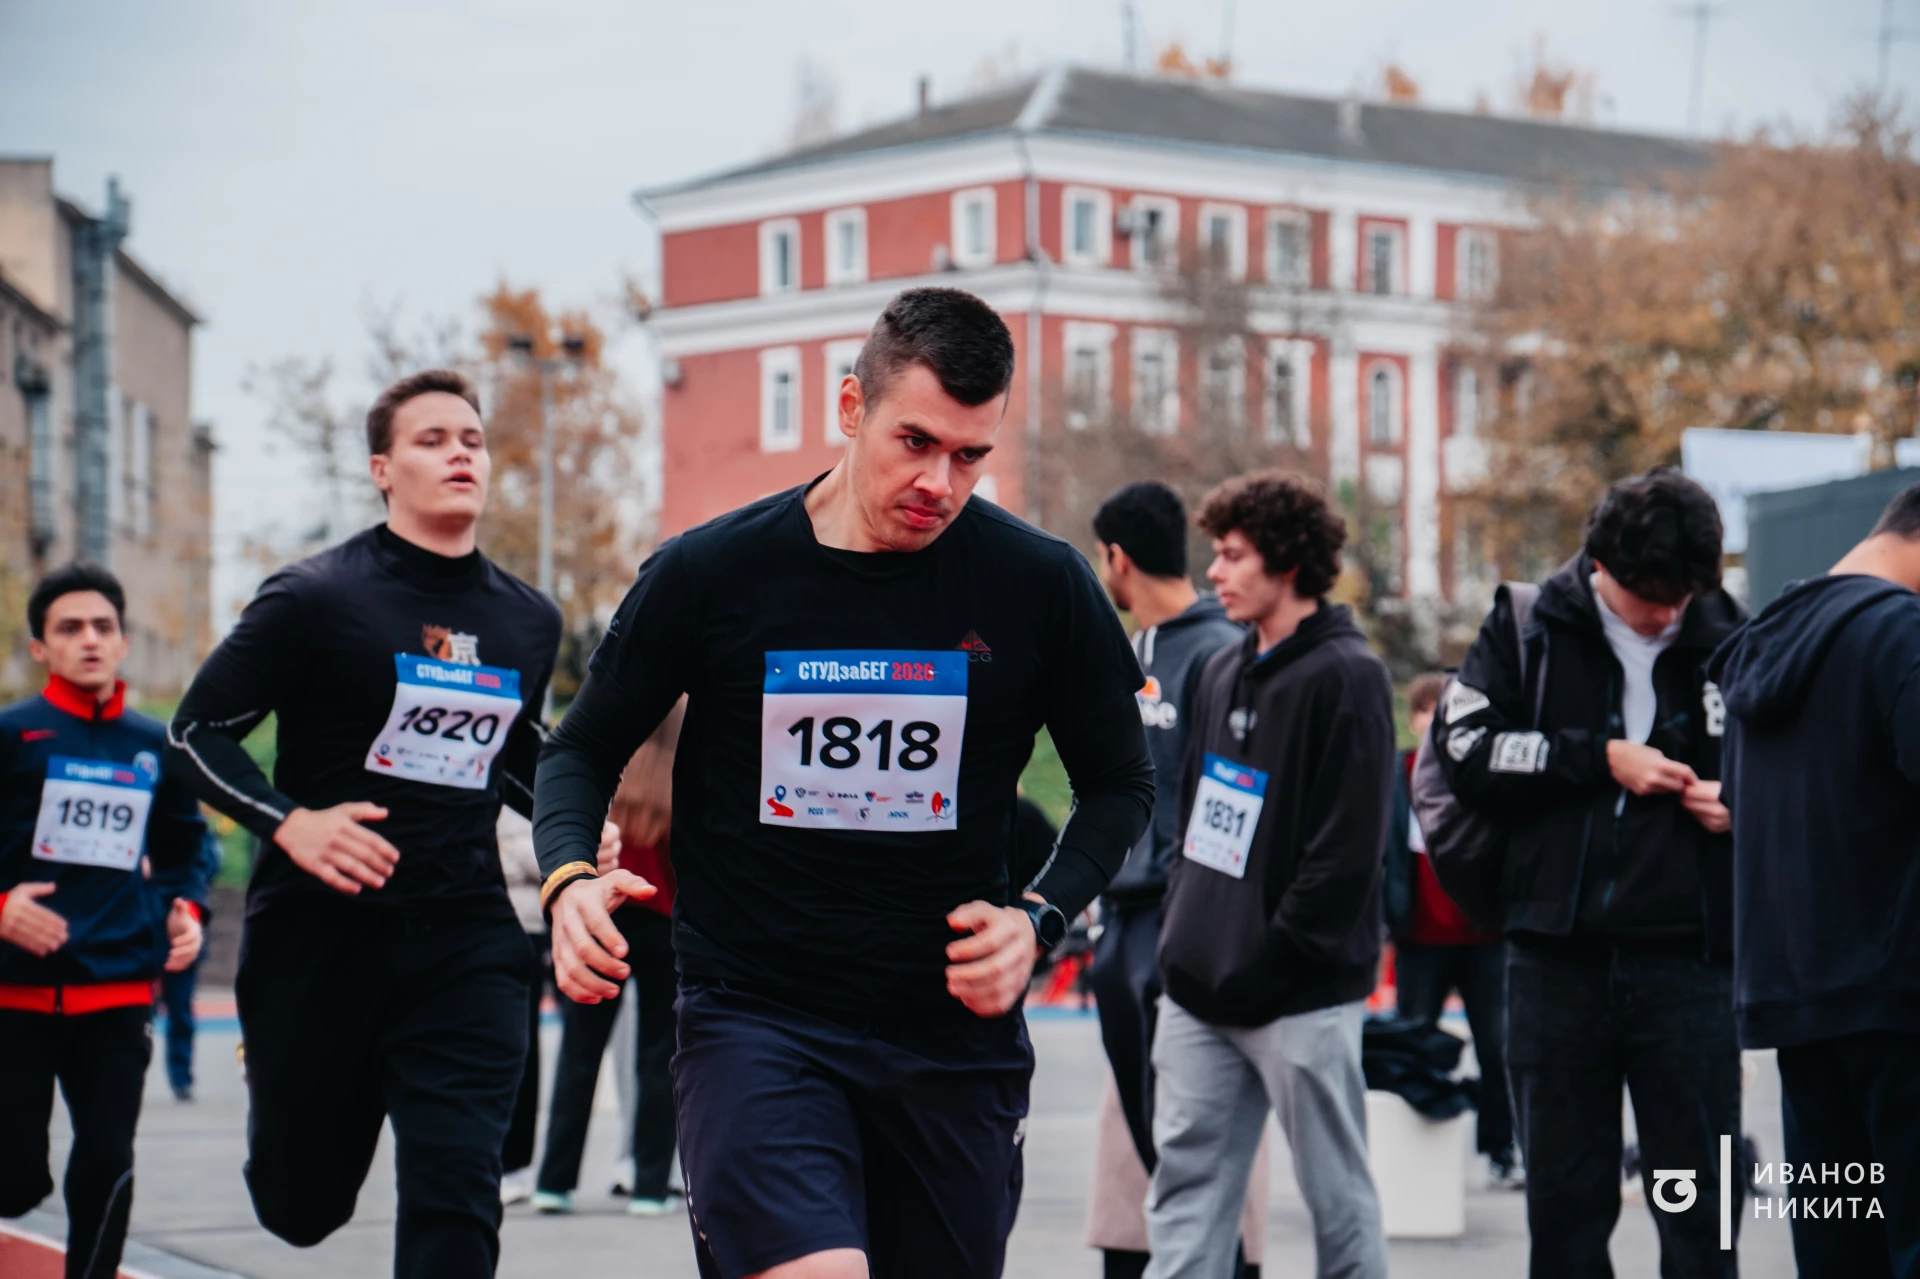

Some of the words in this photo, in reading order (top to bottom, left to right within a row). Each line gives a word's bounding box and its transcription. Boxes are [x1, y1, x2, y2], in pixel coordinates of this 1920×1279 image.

[798, 661, 889, 682] СТУДзаБЕГ
[892, 661, 935, 681] 2026
[398, 705, 500, 746] 1820
[787, 716, 941, 771] 1818
[58, 797, 134, 832] 1819
[1203, 797, 1248, 838] 1831
